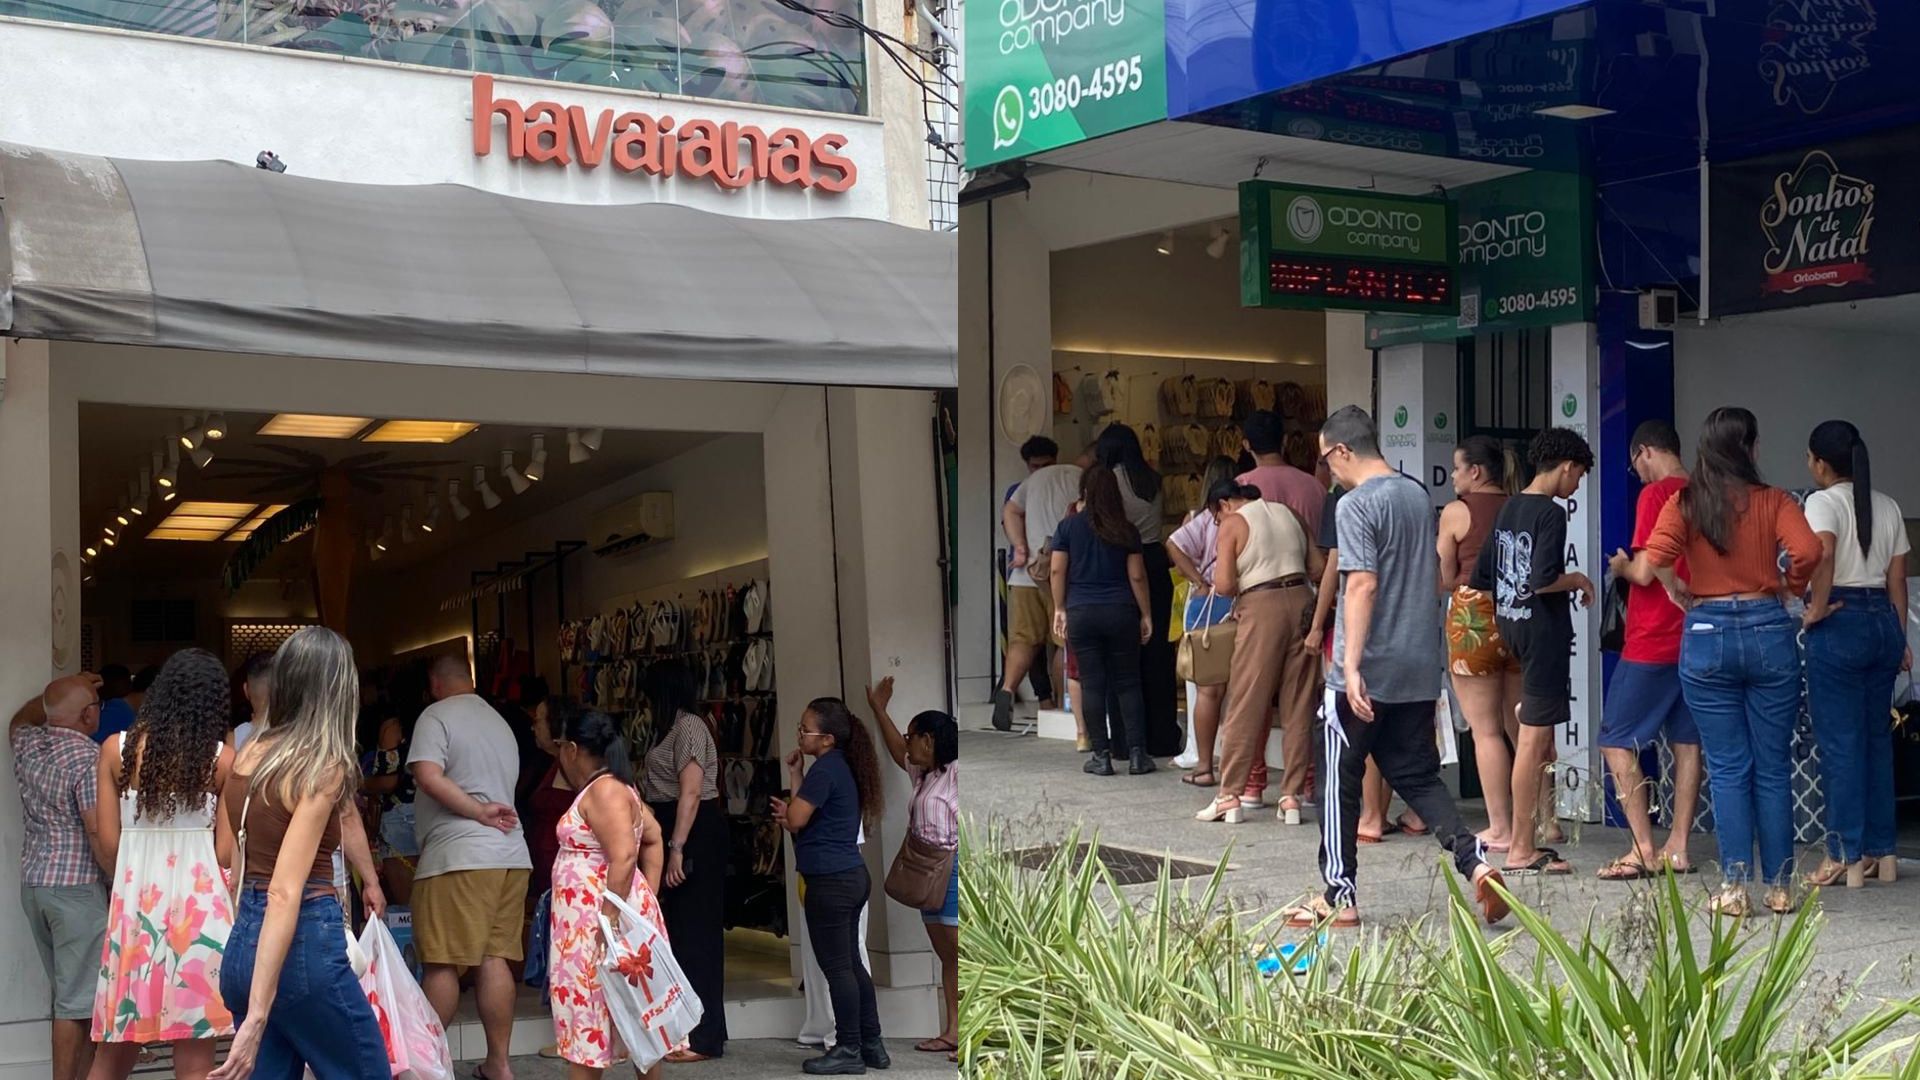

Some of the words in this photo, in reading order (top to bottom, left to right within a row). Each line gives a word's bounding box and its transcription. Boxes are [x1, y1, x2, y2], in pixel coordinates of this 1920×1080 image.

[999, 0, 1125, 54] company
[1028, 55, 1143, 119] 3080-4595
[472, 74, 857, 194] havaianas
[1327, 206, 1422, 232] ODONTO
[1762, 172, 1875, 227] Sonhos
[1820, 212, 1840, 233] de
[1347, 231, 1420, 253] company
[1763, 216, 1875, 275] Natal
[1499, 287, 1577, 315] 3080-4595
